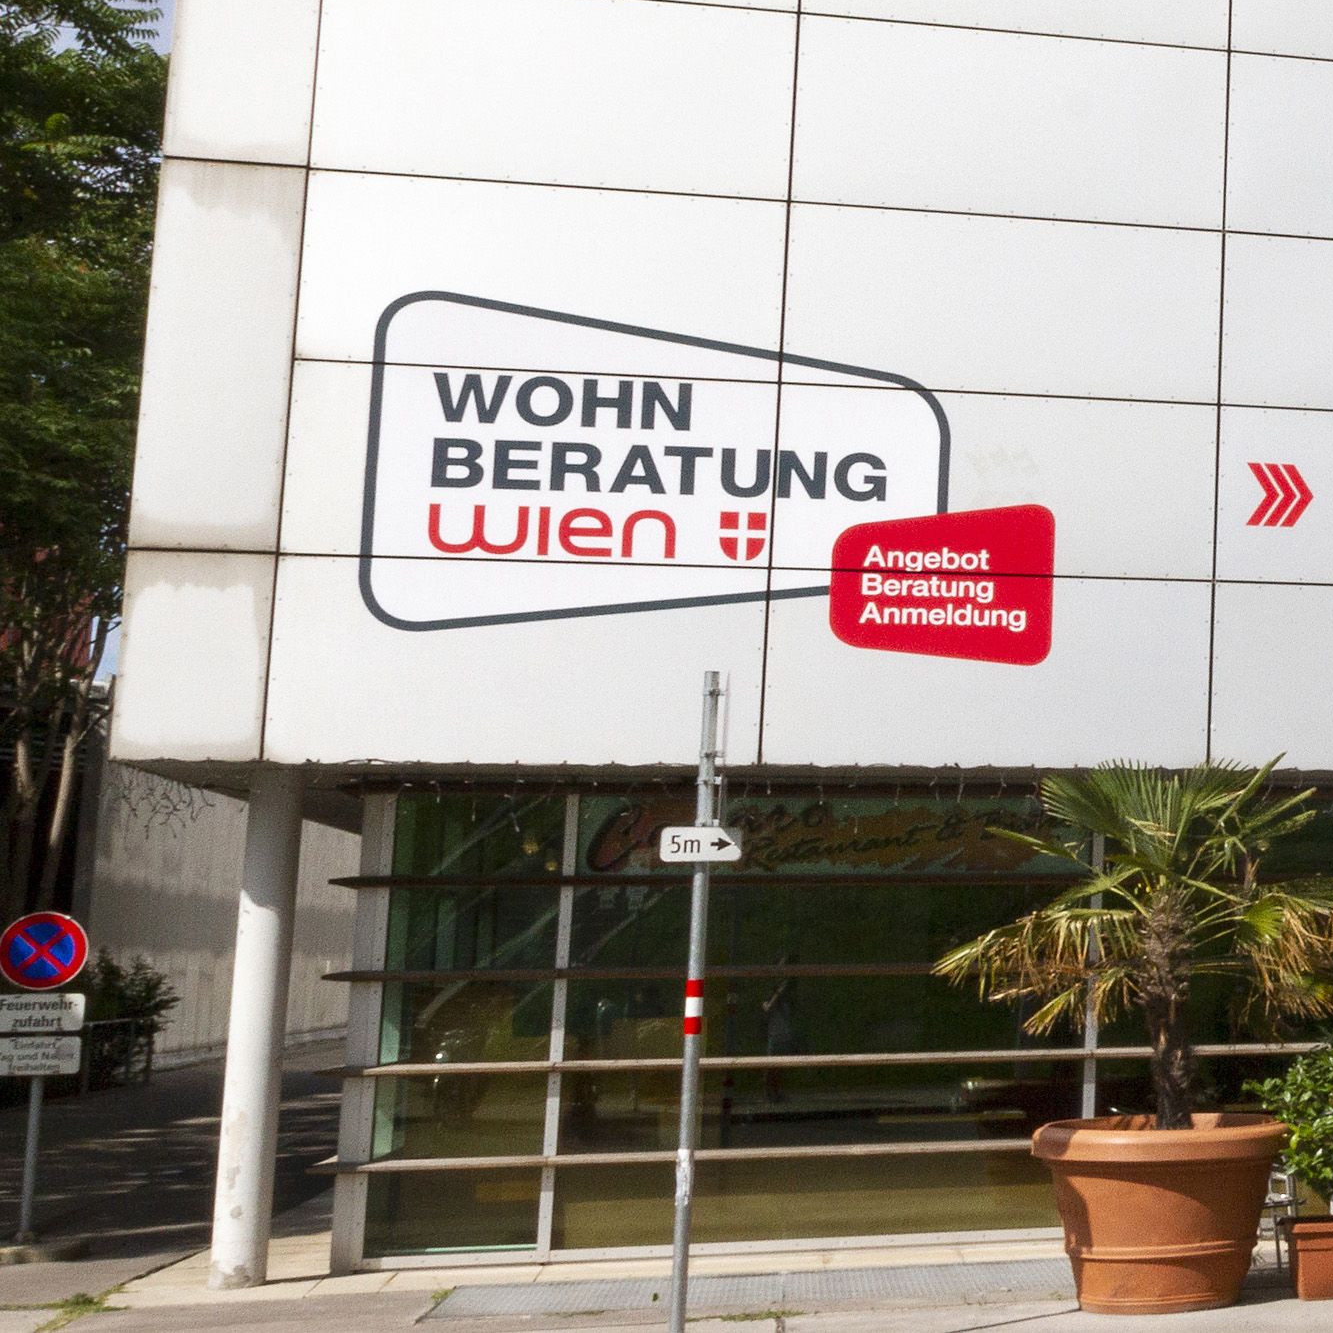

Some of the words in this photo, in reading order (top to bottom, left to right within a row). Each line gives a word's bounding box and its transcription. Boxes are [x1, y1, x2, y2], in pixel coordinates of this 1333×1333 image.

[434, 372, 693, 431] WOHN
[430, 437, 888, 503] BERATUNG
[862, 544, 991, 573] Angebot
[861, 572, 995, 604] Beratung
[858, 601, 1028, 633] Anmeldung
[670, 834, 701, 854] 5m
